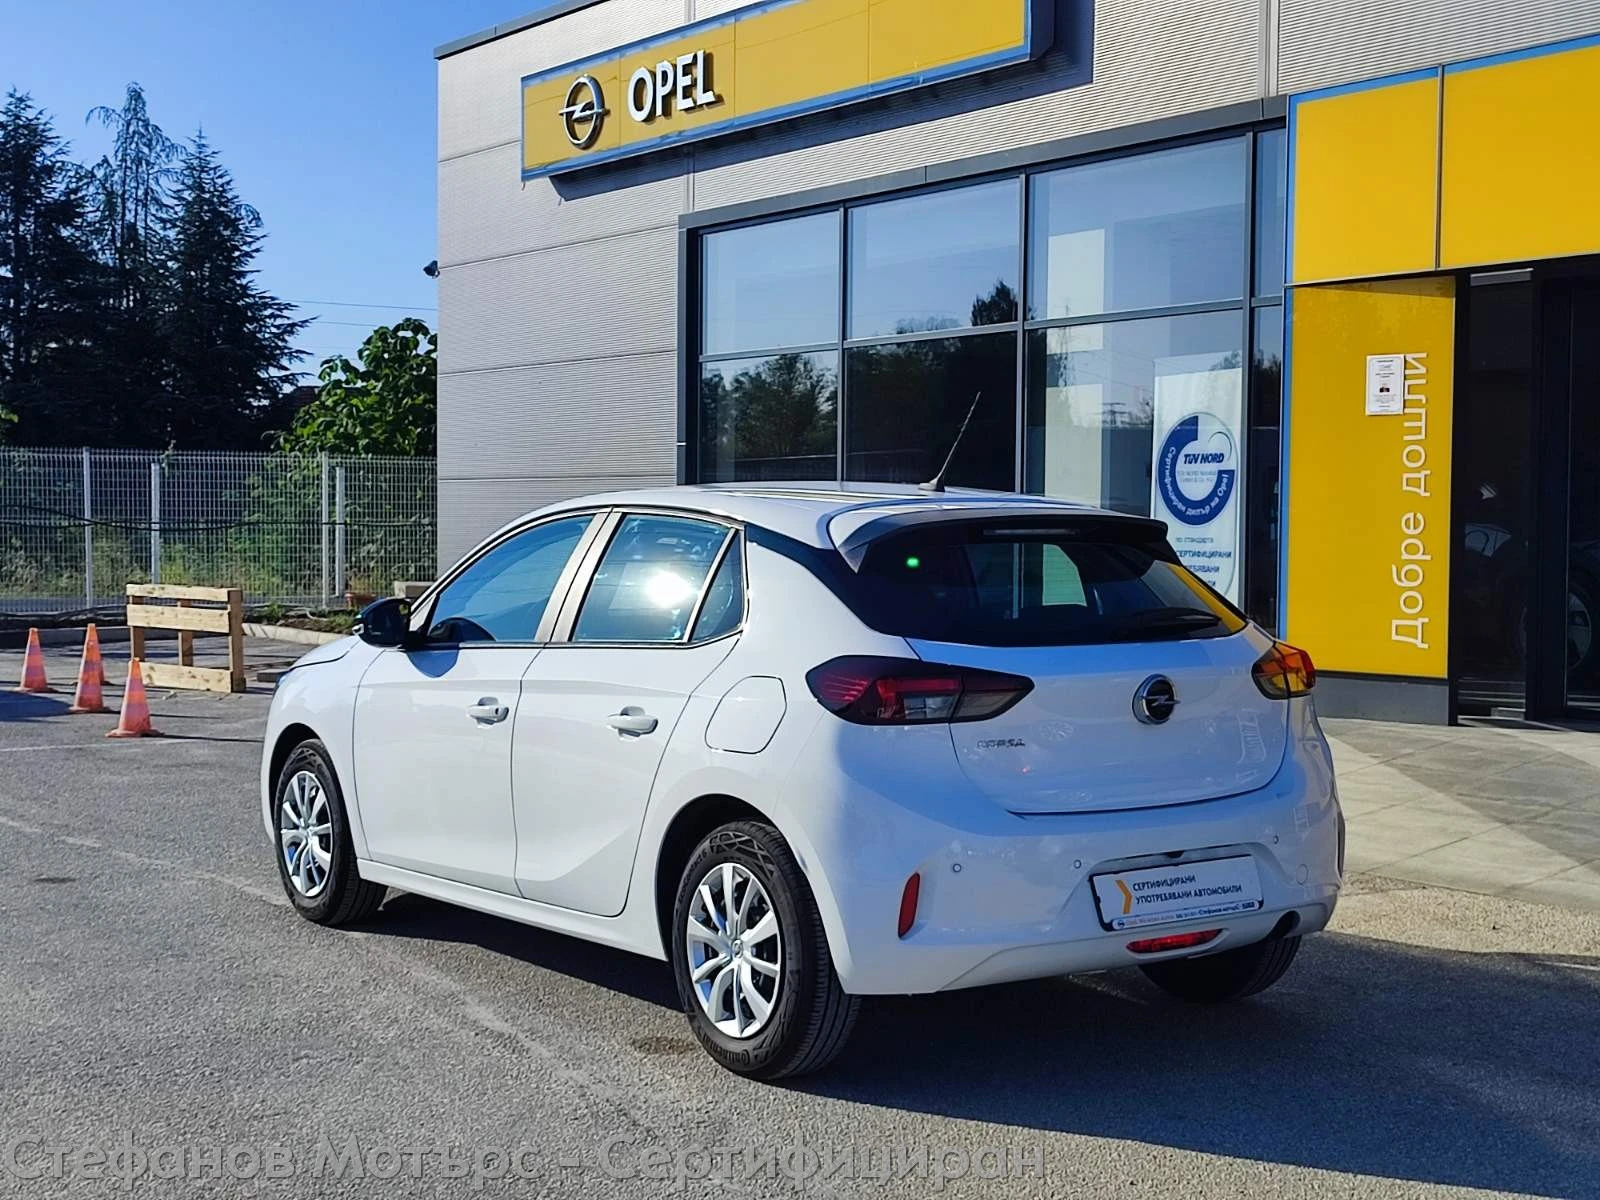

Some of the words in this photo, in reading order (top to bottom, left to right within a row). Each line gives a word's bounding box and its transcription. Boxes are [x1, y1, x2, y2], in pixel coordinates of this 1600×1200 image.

[628, 50, 716, 122] OPEL
[1402, 352, 1431, 497] дошли
[1200, 452, 1225, 463] NORD
[1391, 511, 1432, 649] Добре
[1132, 874, 1197, 892] СЕРТИФИЦИРАНИ
[1136, 890, 1193, 905] УПОТРЕБЯВАНИ
[1193, 884, 1242, 897] АВТОМОБИЛИ
